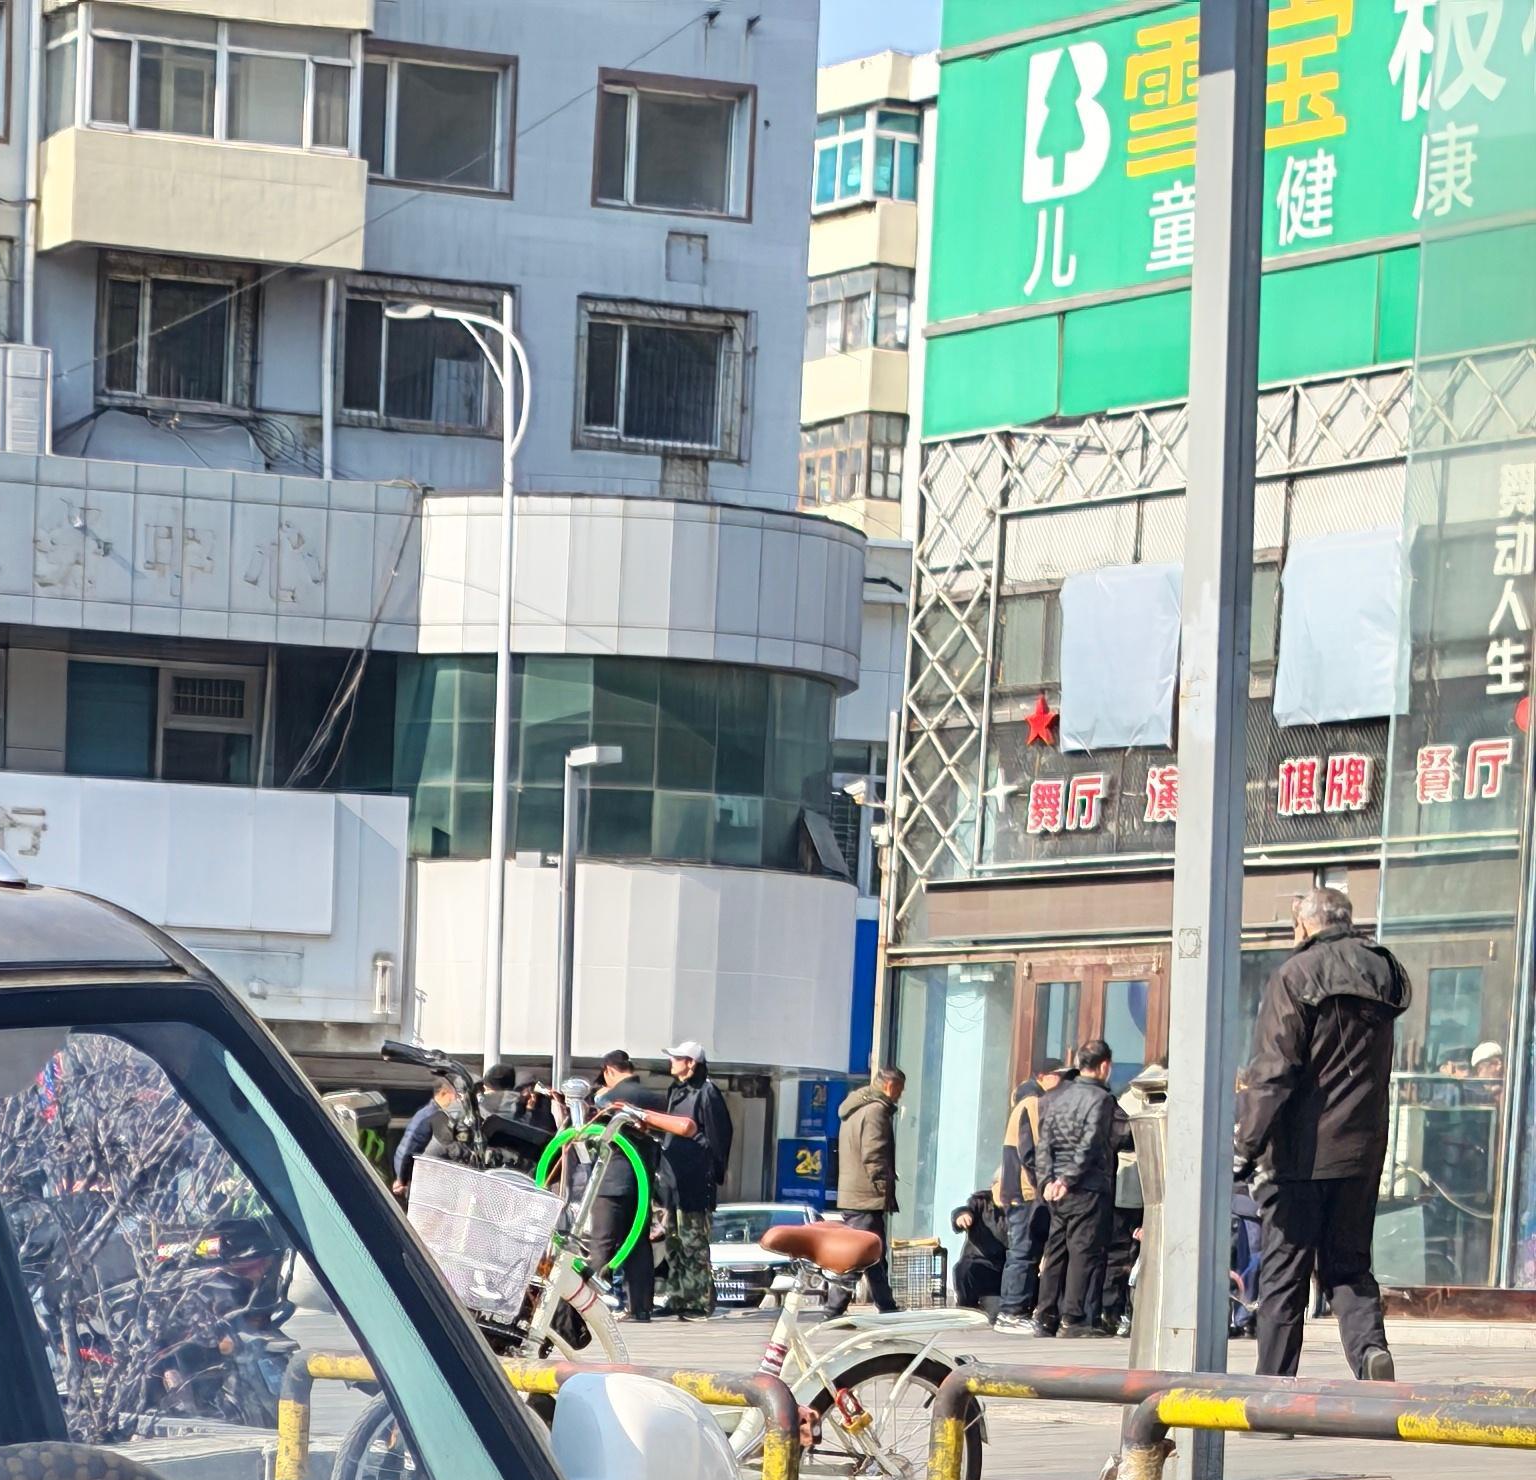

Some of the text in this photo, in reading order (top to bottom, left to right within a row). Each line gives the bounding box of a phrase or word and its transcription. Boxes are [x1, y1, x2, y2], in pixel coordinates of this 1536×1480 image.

[1024, 122, 1480, 296] 儿童健康
[1027, 773, 1105, 833] 舞厅
[1277, 752, 1371, 817] 棋牌
[1417, 738, 1512, 804] 餐厅
